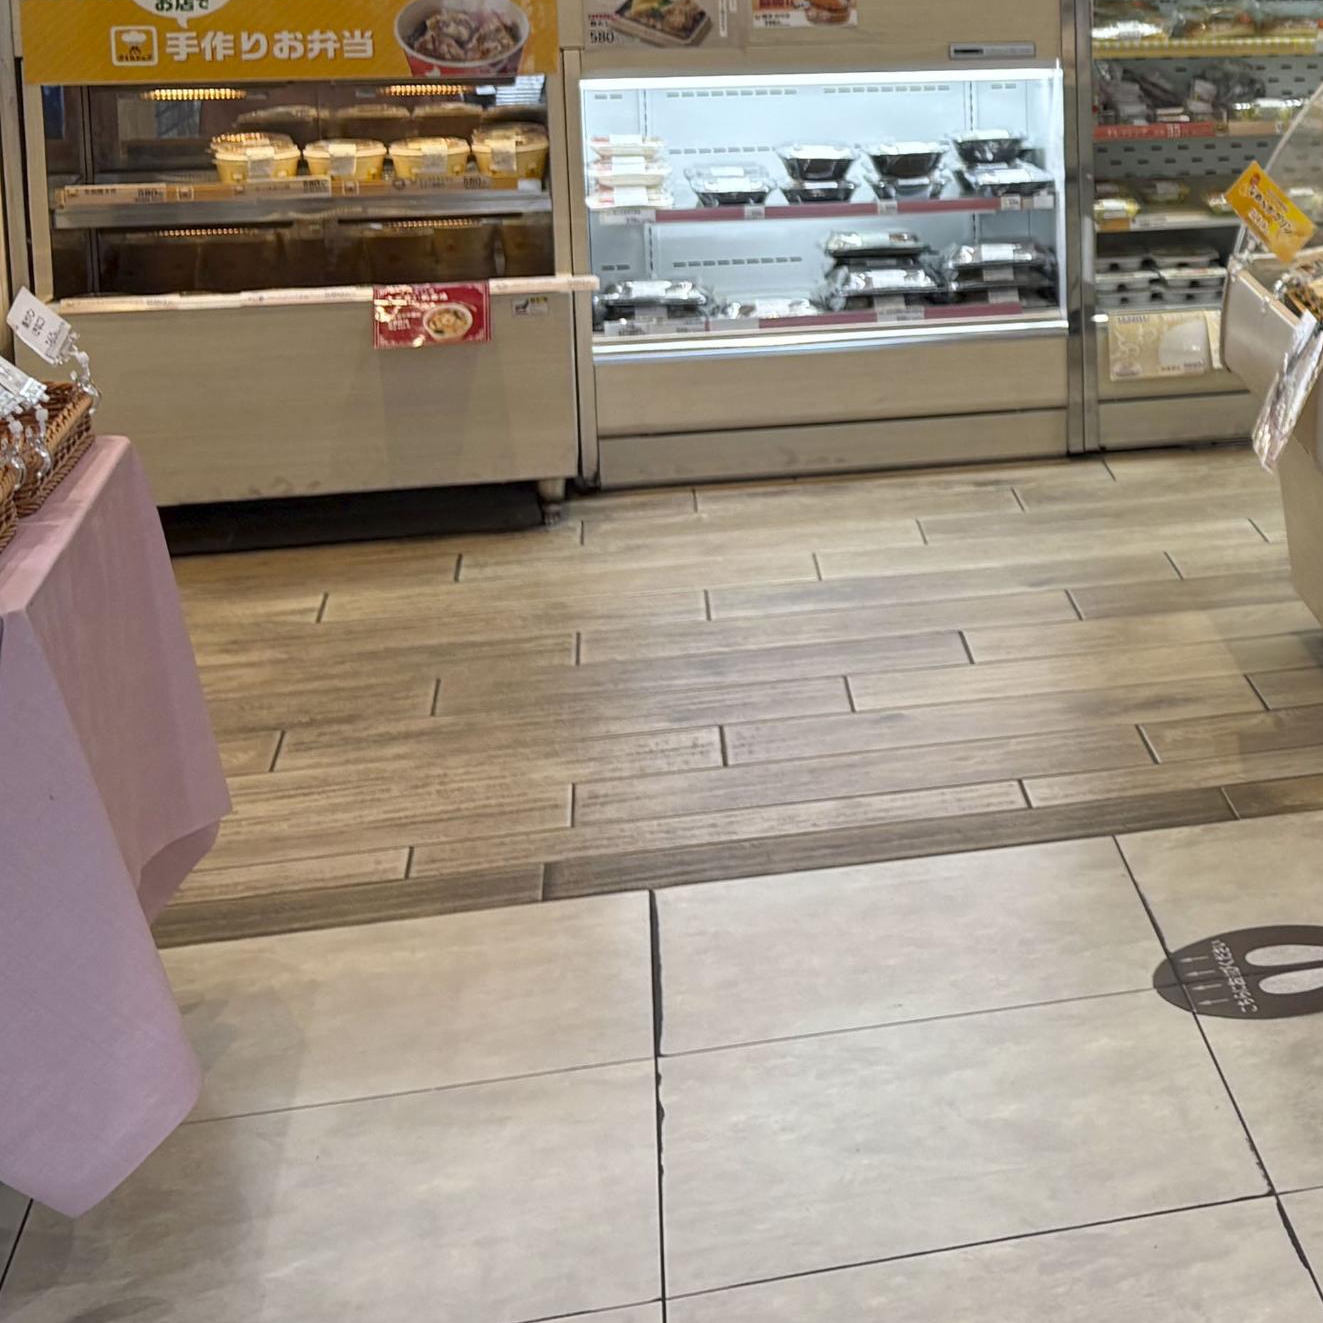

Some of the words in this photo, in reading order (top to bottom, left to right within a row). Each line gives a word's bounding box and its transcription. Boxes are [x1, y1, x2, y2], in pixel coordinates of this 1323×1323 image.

[165, 30, 374, 61] 手作りお弁当
